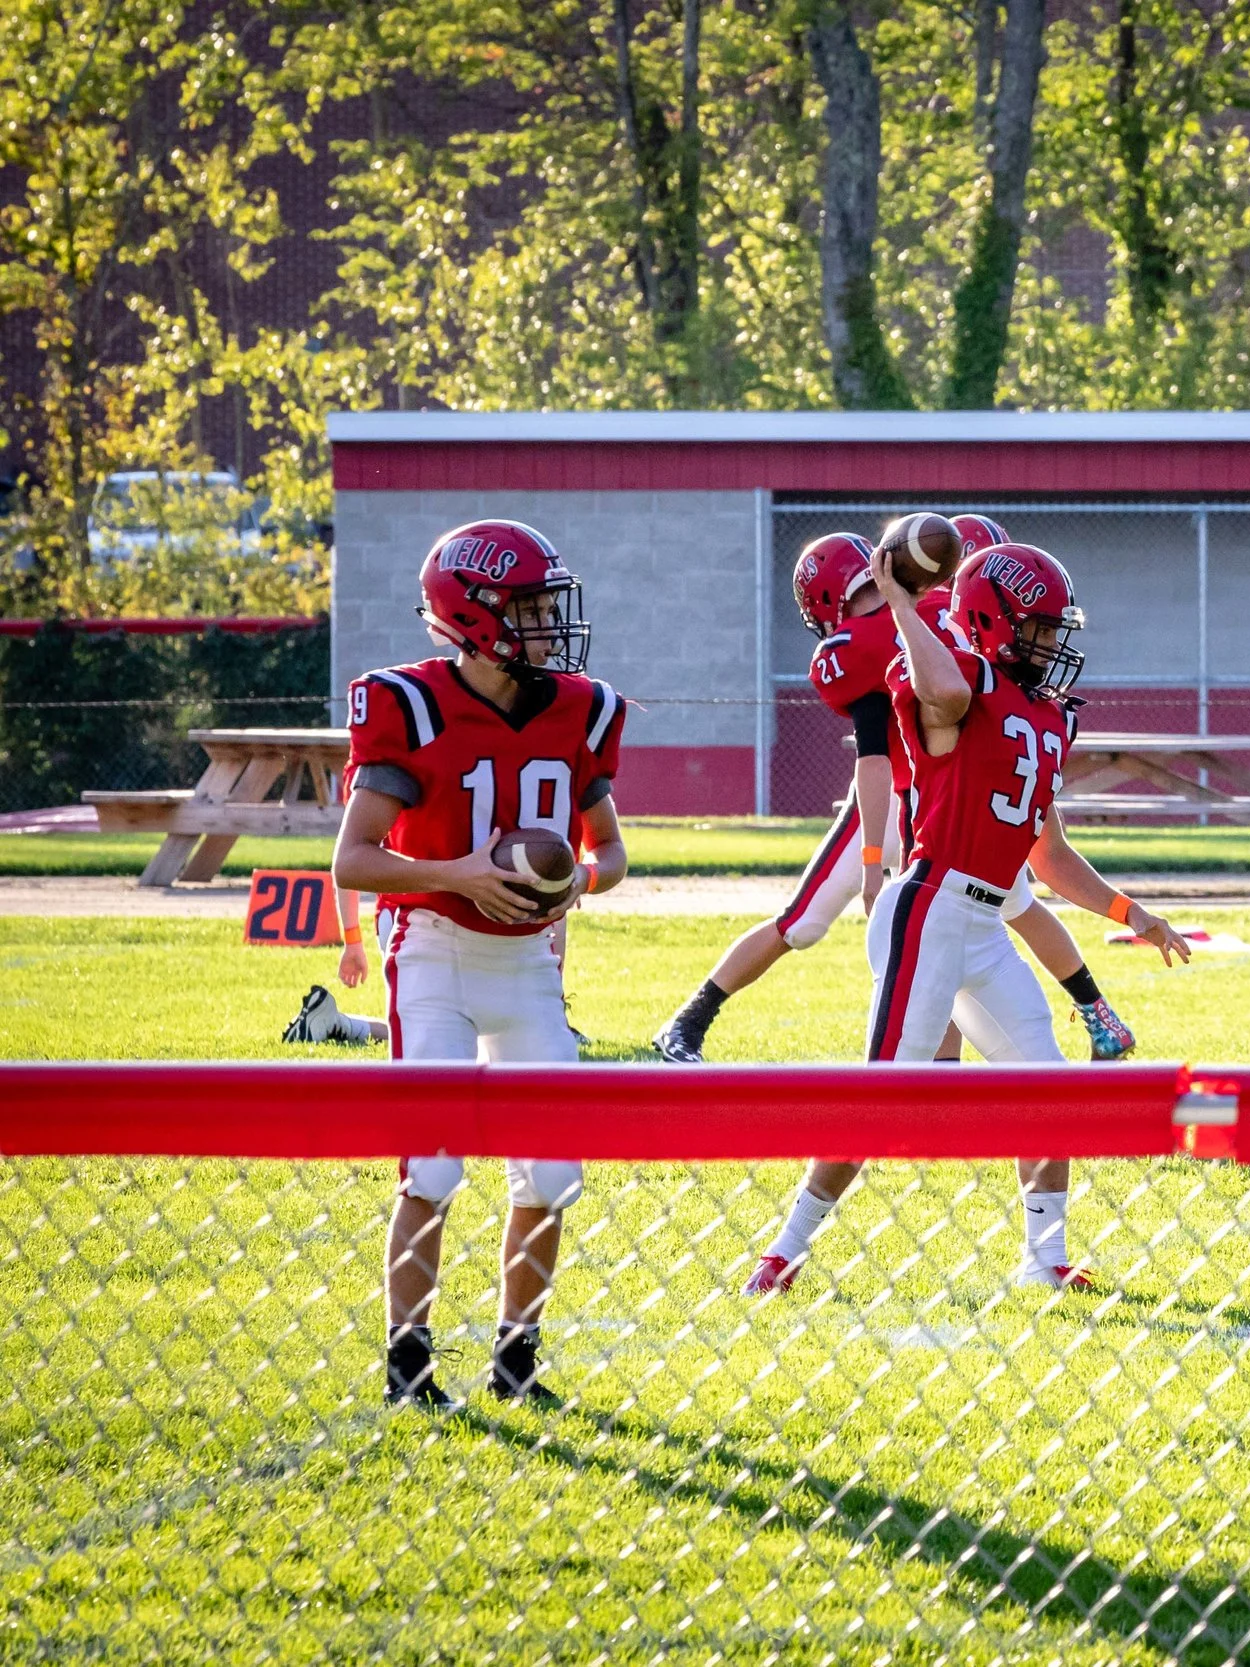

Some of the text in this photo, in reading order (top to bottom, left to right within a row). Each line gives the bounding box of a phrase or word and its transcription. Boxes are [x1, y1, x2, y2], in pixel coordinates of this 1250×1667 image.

[440, 536, 517, 582] WELLS
[981, 553, 1047, 608] WELLS
[816, 652, 845, 685] 21
[990, 714, 1064, 838] 33
[249, 876, 325, 942] 20
